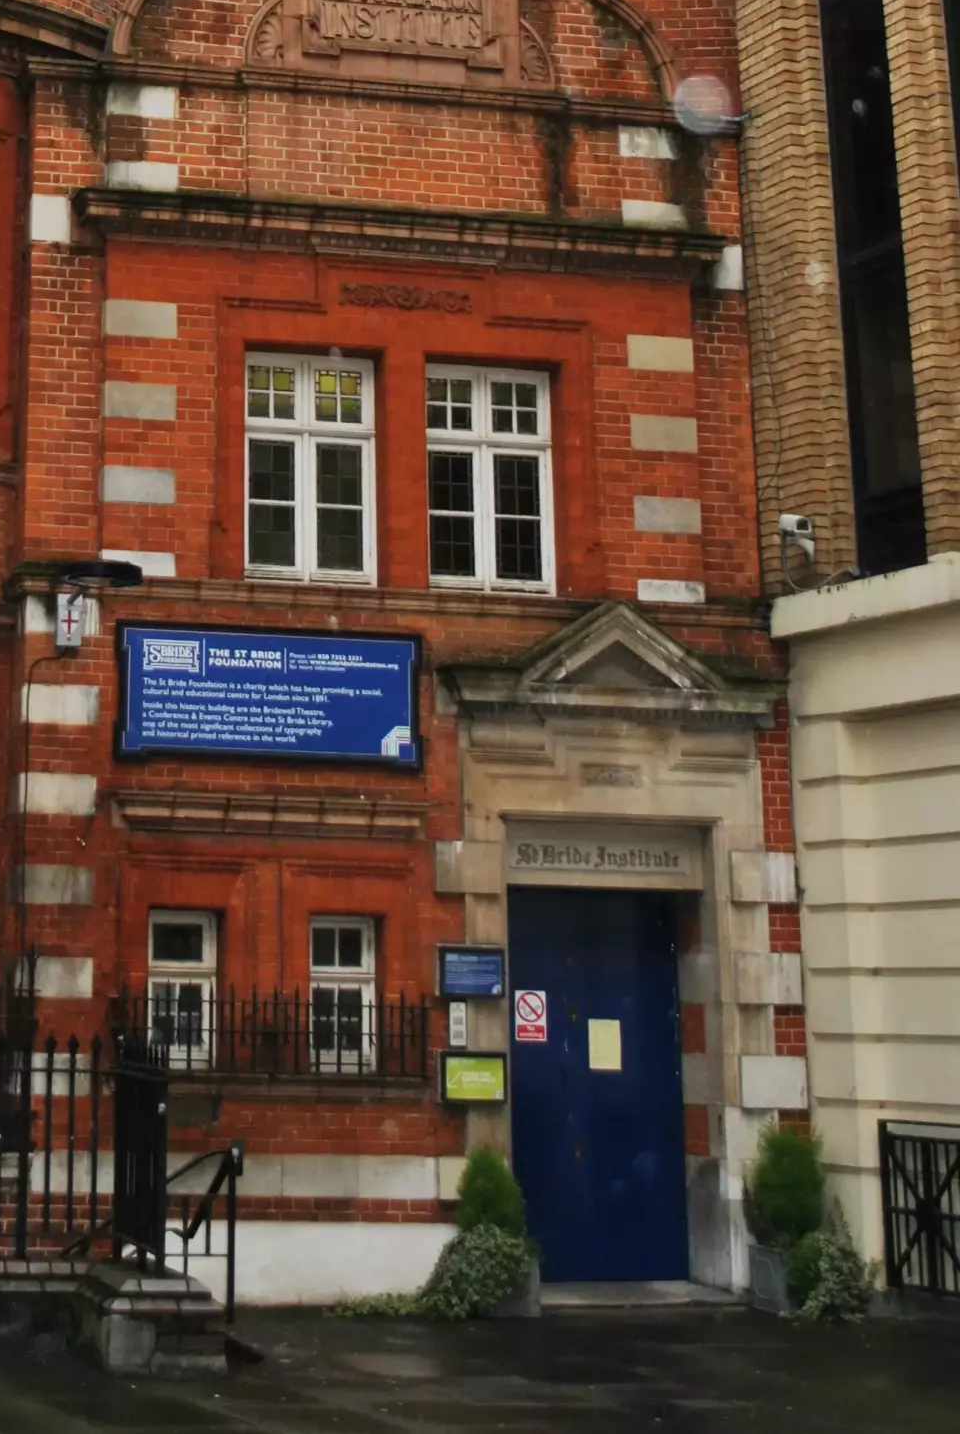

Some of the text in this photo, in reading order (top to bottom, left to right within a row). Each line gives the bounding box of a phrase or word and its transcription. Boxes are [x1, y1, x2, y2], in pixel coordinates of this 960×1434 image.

[321, 2, 482, 48] INSTITUTE
[161, 646, 193, 658] BRIDE
[209, 648, 281, 659] THE ST BRIDE
[208, 658, 282, 669] FOUNDATION
[143, 677, 157, 685] The
[168, 679, 187, 687] Bride
[189, 680, 228, 688] Foundation
[243, 682, 266, 691] charity
[269, 683, 288, 691] which
[303, 685, 321, 693] been
[322, 687, 354, 697] providing
[361, 689, 383, 697] social,
[186, 690, 225, 698] educational
[251, 691, 261, 699] for
[264, 692, 290, 702] London
[292, 694, 309, 702] since
[312, 695, 330, 703] 1891.
[143, 701, 163, 709] Inside
[180, 702, 206, 710] historic
[208, 703, 235, 713] building
[250, 705, 261, 713] the
[263, 706, 296, 716] Bridewell
[296, 708, 325, 716] Theatre,
[148, 711, 189, 719] Conference
[191, 712, 197, 720] &
[200, 712, 222, 721] Events
[223, 714, 248, 722] Centre
[250, 715, 263, 723] and
[265, 715, 276, 723] the
[278, 715, 285, 723] St
[287, 717, 305, 725] Bride
[307, 718, 333, 727] Library,
[158, 720, 166, 728] of
[200, 722, 234, 732] significant
[236, 724, 273, 733] collections
[275, 725, 283, 733] of
[284, 728, 322, 736] typography
[157, 730, 189, 738] historical
[190, 731, 216, 739] printed
[218, 732, 250, 740] reference
[262, 734, 273, 742] the
[275, 735, 297, 743] world.
[540, 844, 591, 866] Bride
[594, 846, 680, 868] Institute
